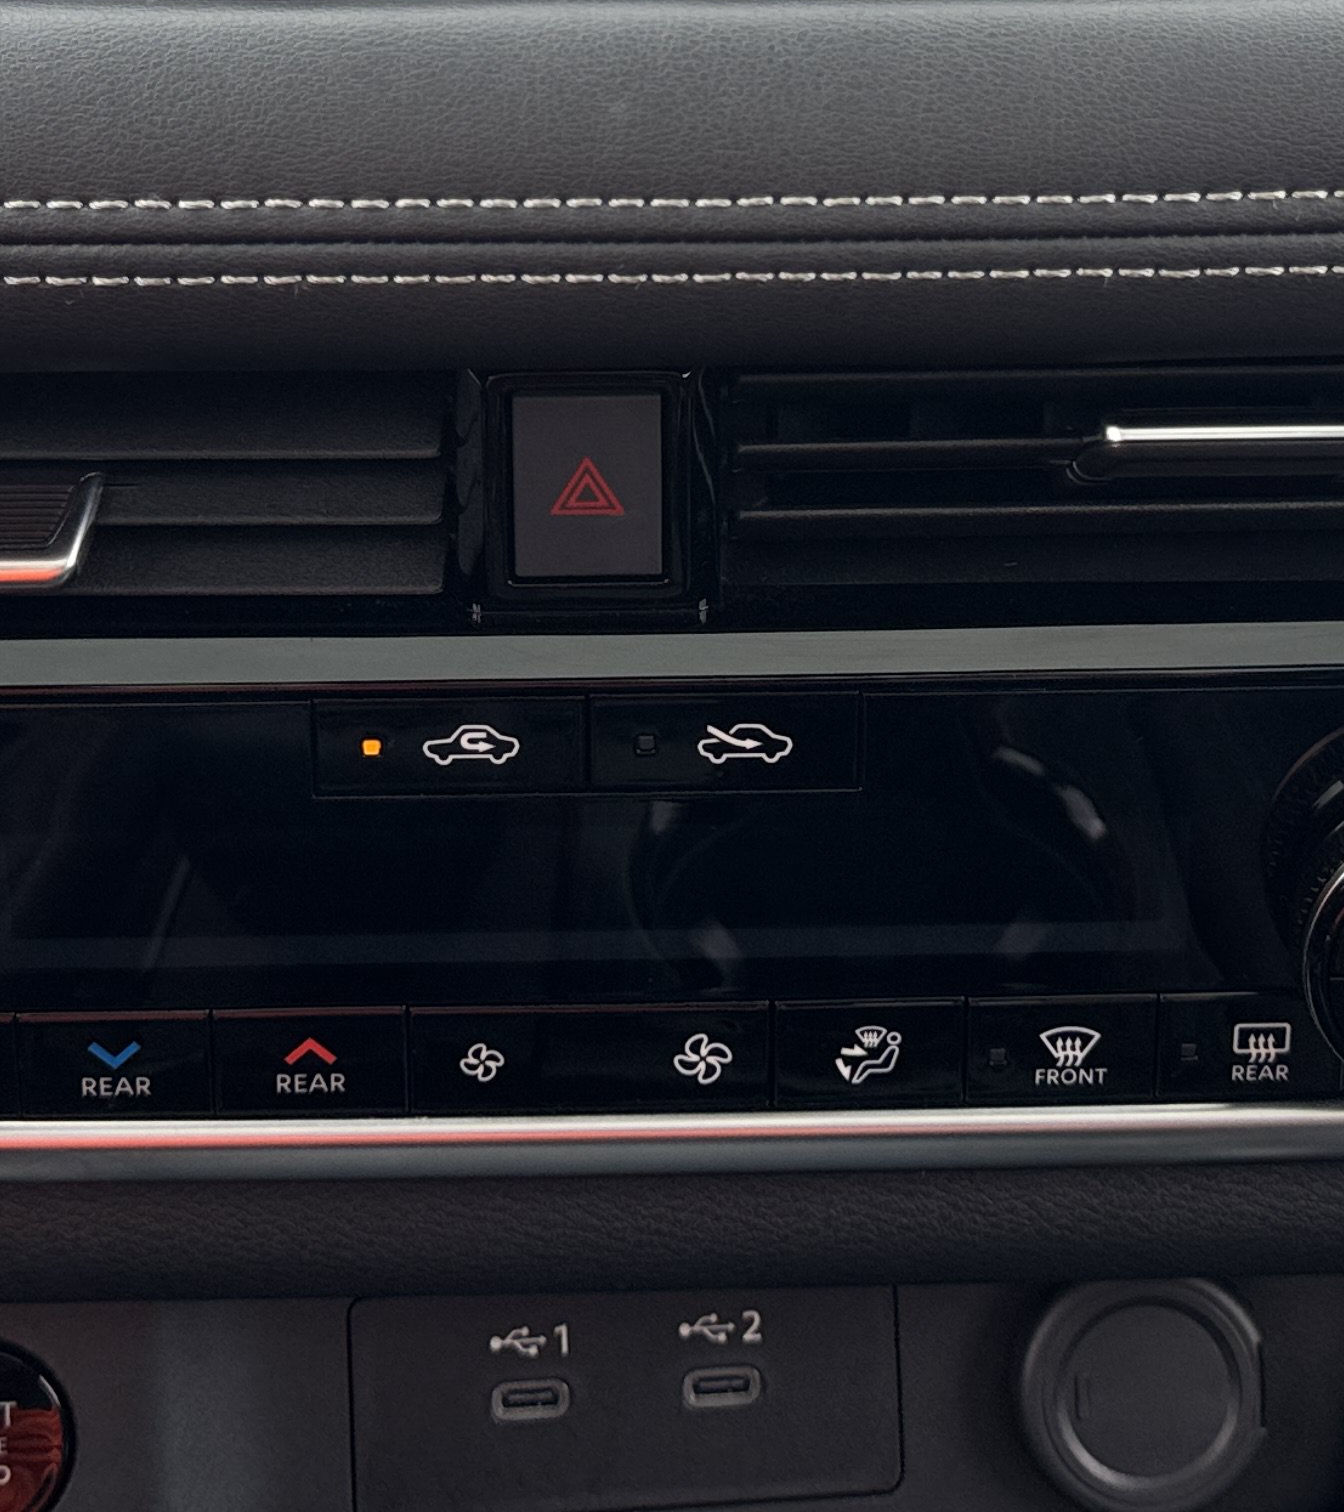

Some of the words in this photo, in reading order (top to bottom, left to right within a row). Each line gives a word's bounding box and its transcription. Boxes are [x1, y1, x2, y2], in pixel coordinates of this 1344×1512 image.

[1035, 1067, 1107, 1085] FRONT
[1231, 1064, 1289, 1081] REAR
[81, 1076, 151, 1096] REAR
[276, 1073, 345, 1093] REAR
[742, 1310, 762, 1342] 2
[554, 1323, 568, 1355] 1
